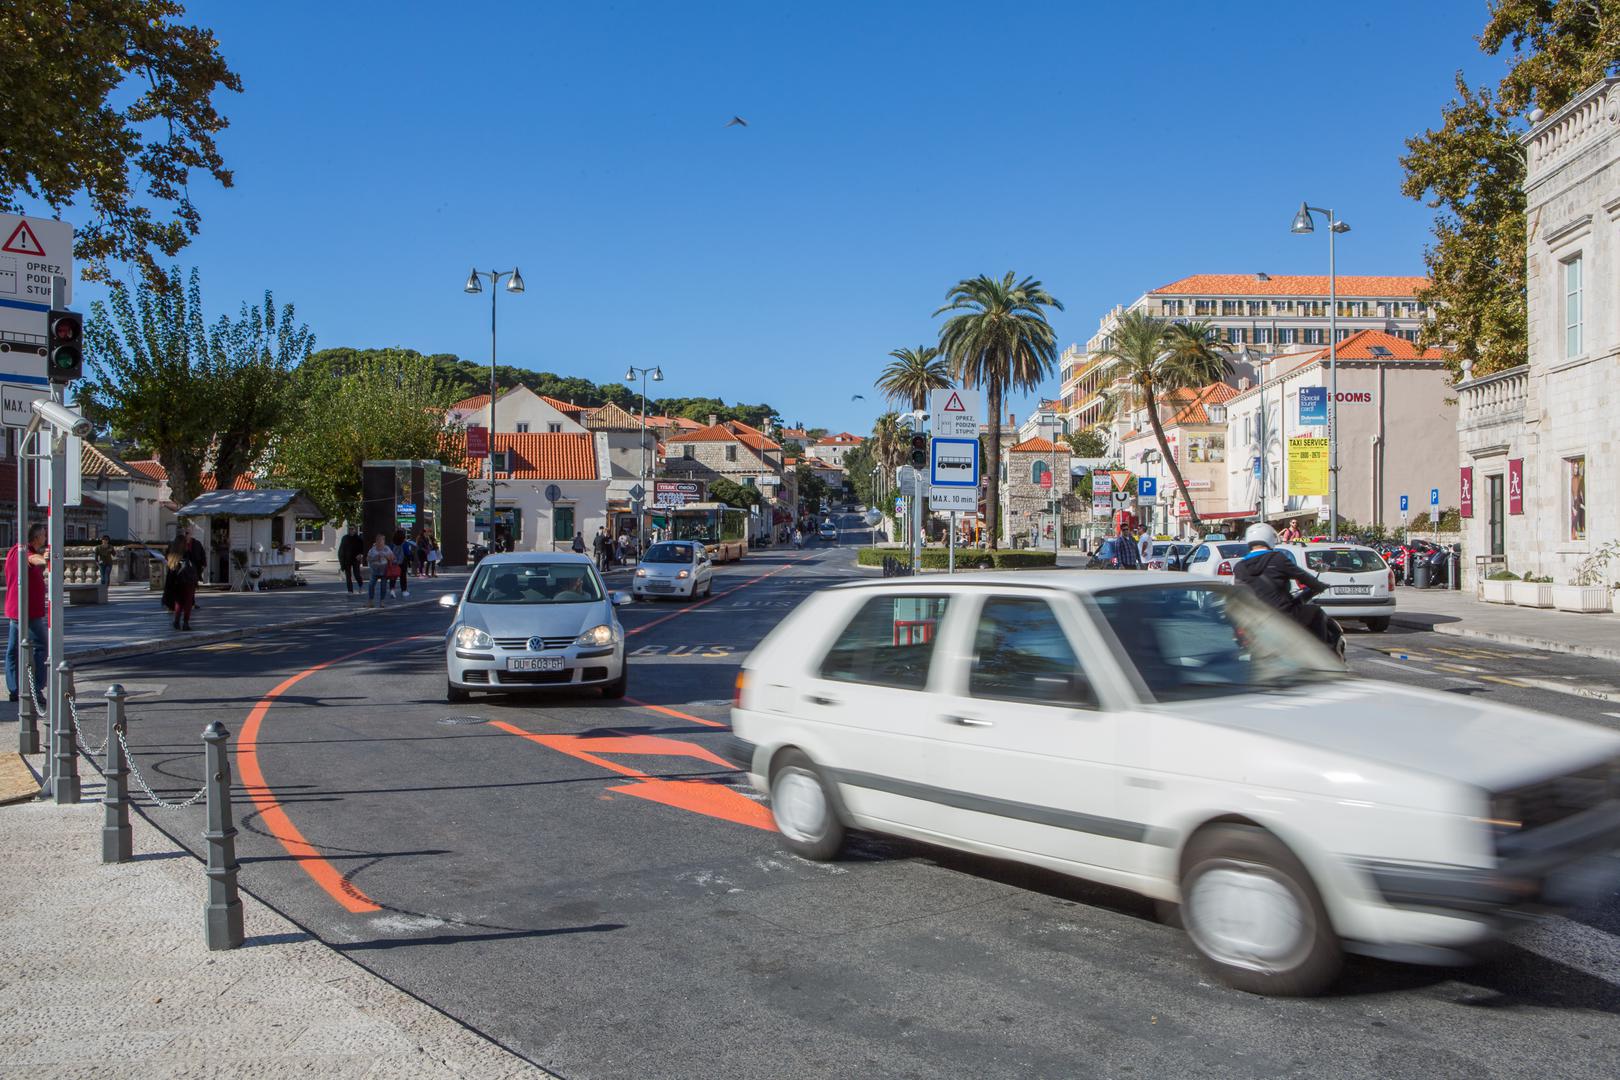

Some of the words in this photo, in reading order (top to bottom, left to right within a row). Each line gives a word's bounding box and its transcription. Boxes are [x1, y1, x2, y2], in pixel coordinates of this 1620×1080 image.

[26, 262, 64, 275] OPREZ,
[4, 397, 27, 413] MAX.
[1143, 480, 1152, 493] P
[932, 494, 951, 503] MAX.
[960, 496, 975, 504] min.
[627, 643, 736, 657] BUS
